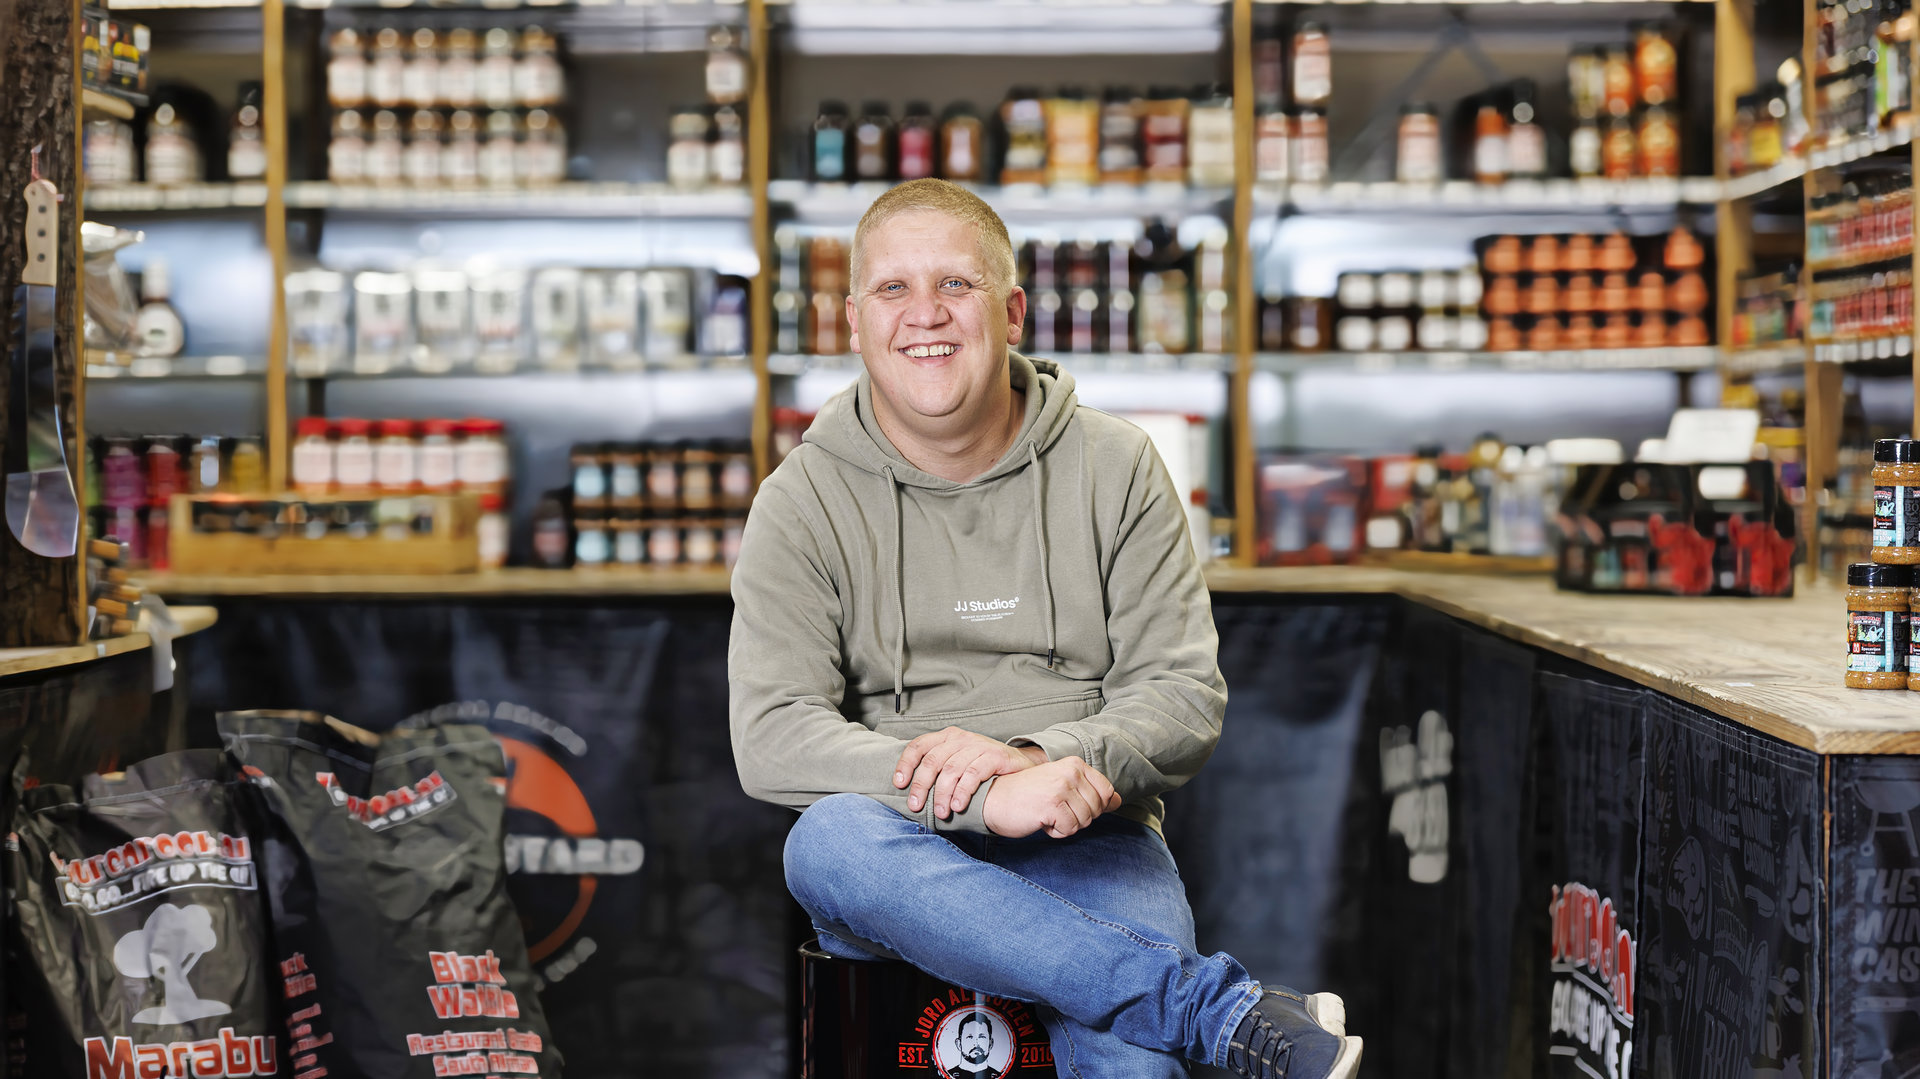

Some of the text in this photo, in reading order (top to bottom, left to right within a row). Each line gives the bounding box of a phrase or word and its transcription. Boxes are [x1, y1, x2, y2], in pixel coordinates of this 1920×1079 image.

[954, 601, 967, 612] JJ
[429, 950, 507, 985] Black
[915, 998, 946, 1038] JORD
[84, 1027, 277, 1079] Marabu
[899, 1047, 928, 1064] EST.
